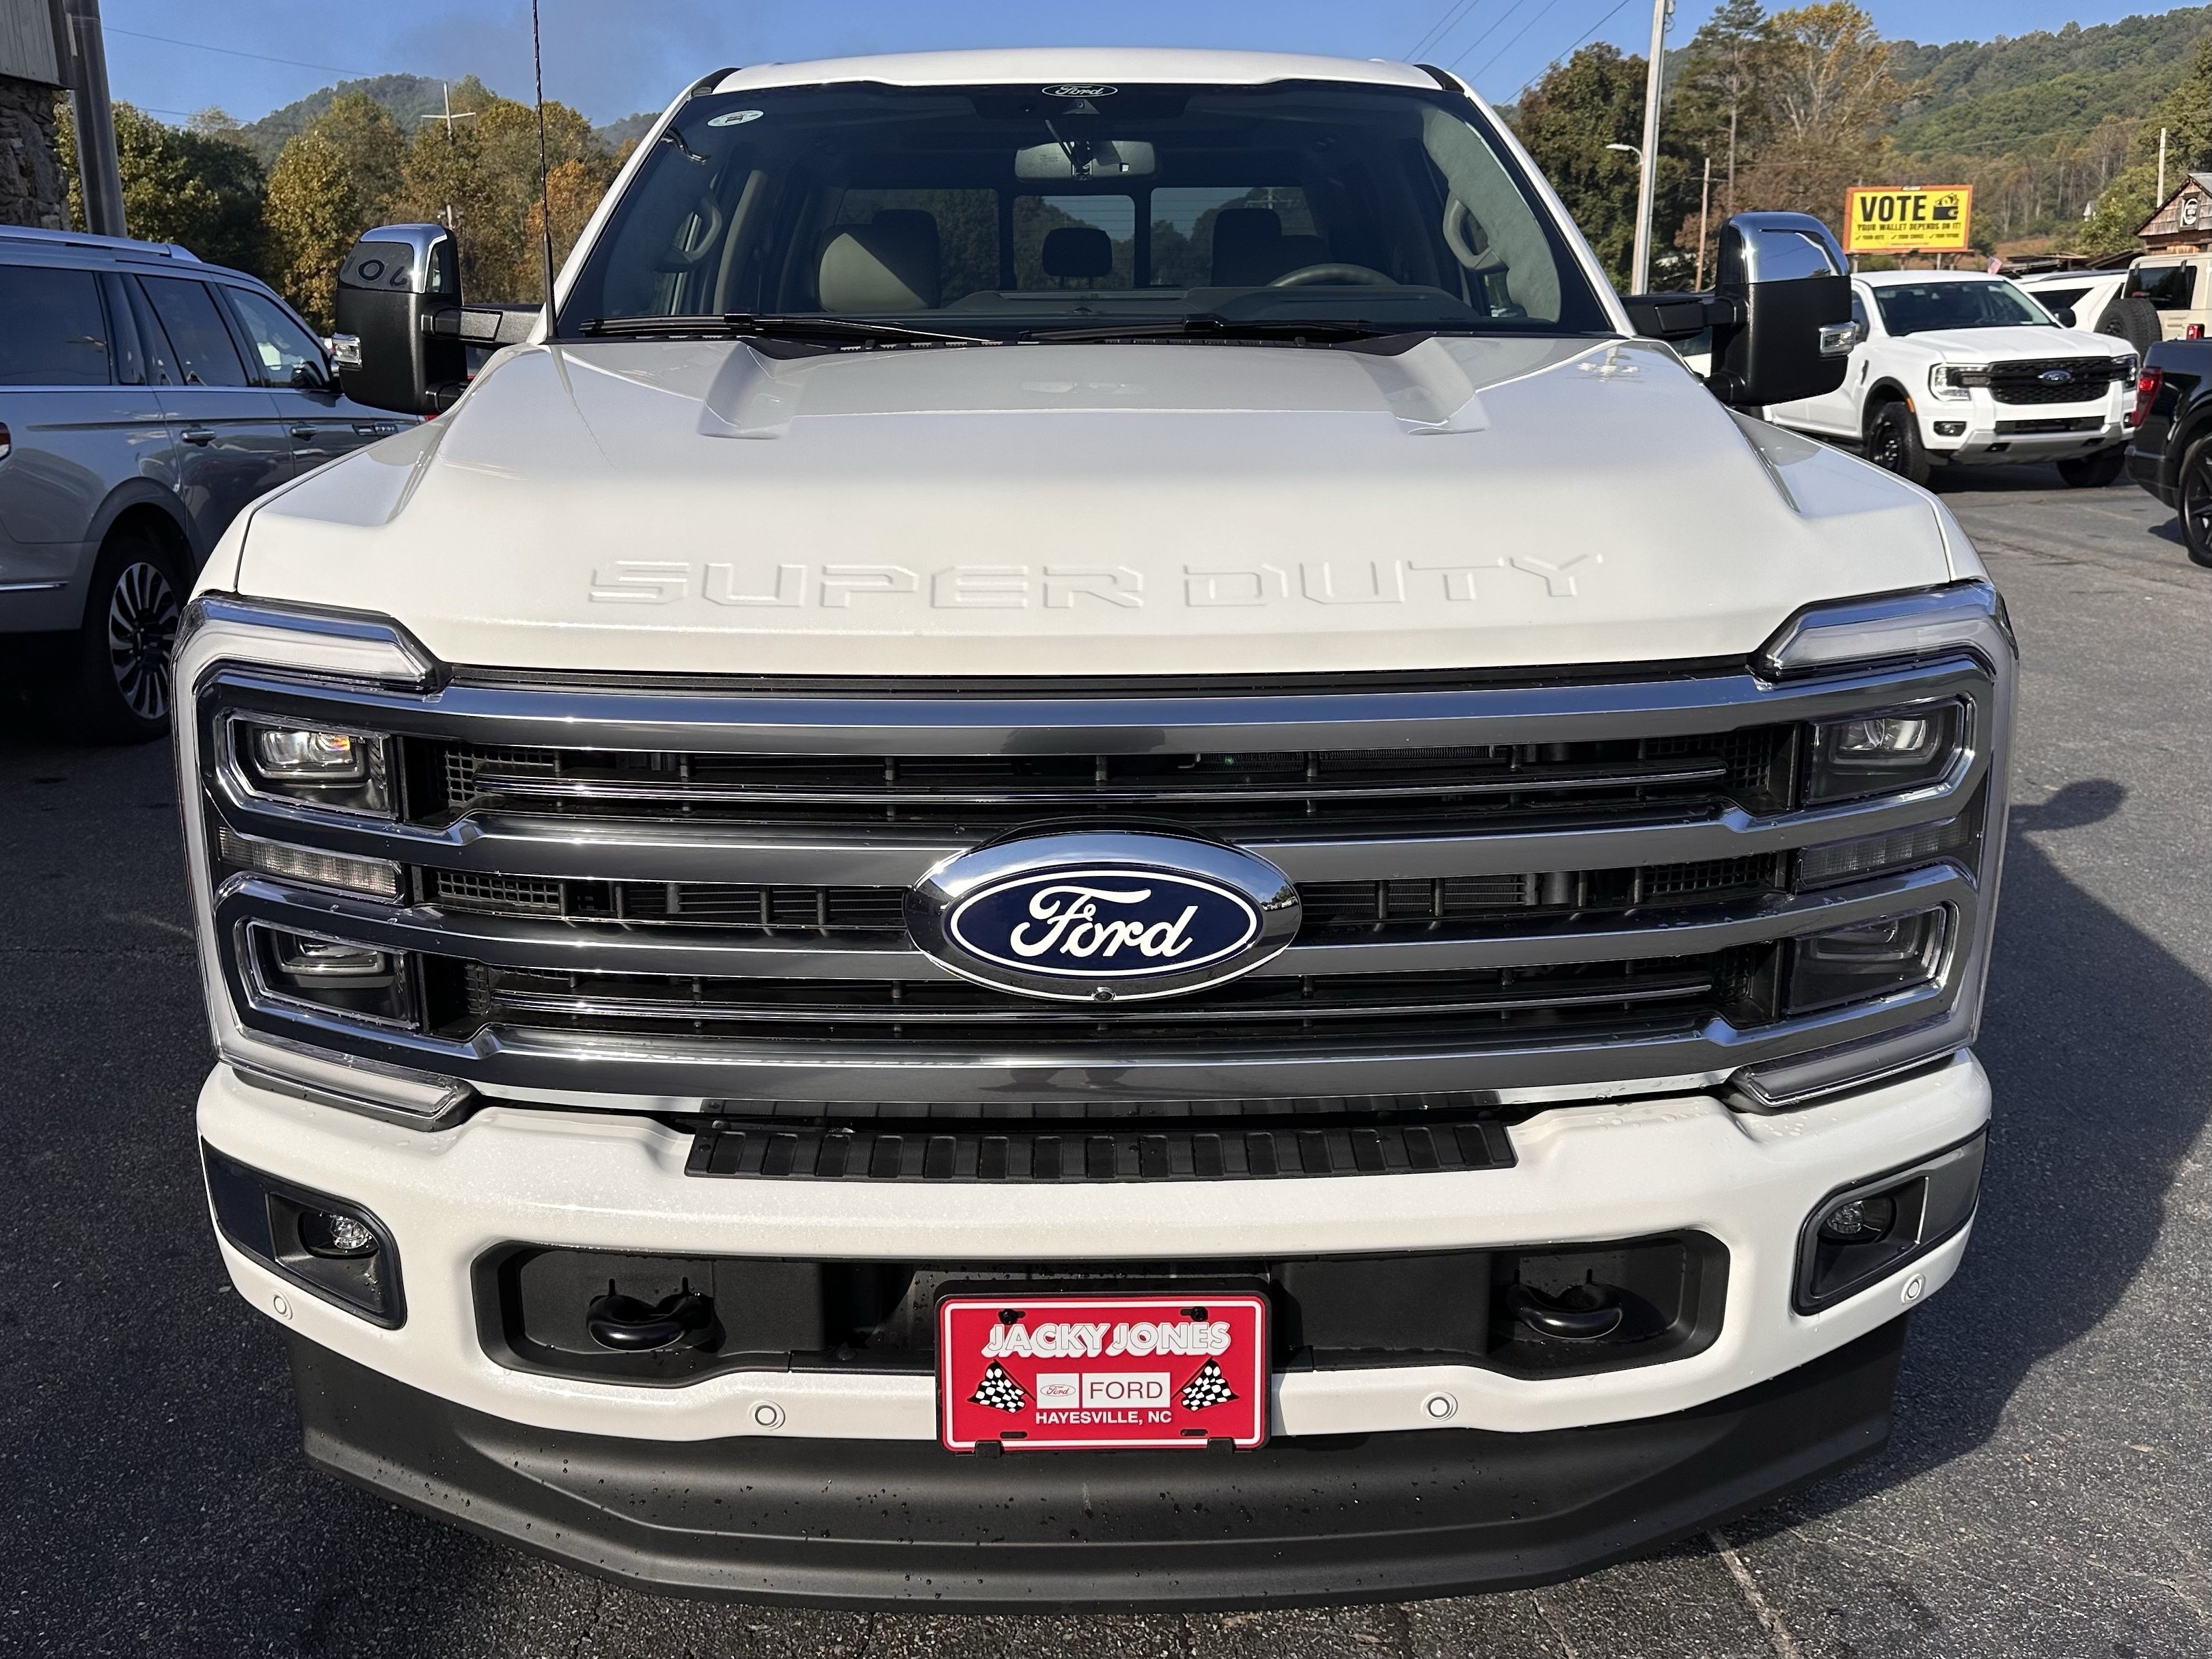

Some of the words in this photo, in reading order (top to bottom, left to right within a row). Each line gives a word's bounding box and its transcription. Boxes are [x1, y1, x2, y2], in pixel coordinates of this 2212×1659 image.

[1054, 85, 1105, 95] Ford
[1859, 195, 1927, 222] VOTE
[1857, 223, 1876, 232] YOUR
[1879, 223, 1907, 231] WALLET
[1909, 223, 1939, 231] DEPENDS
[590, 559, 1143, 609] SUPER
[1183, 553, 1604, 608] DUTY
[1009, 886, 1199, 957] Ford
[981, 1321, 1111, 1358] JACKY
[1105, 1321, 1231, 1357] JONES
[1046, 1384, 1069, 1396] Ford
[1090, 1381, 1163, 1399] FORD
[1035, 1411, 1143, 1425] HAYESVILLE,
[1148, 1410, 1172, 1423] NC
